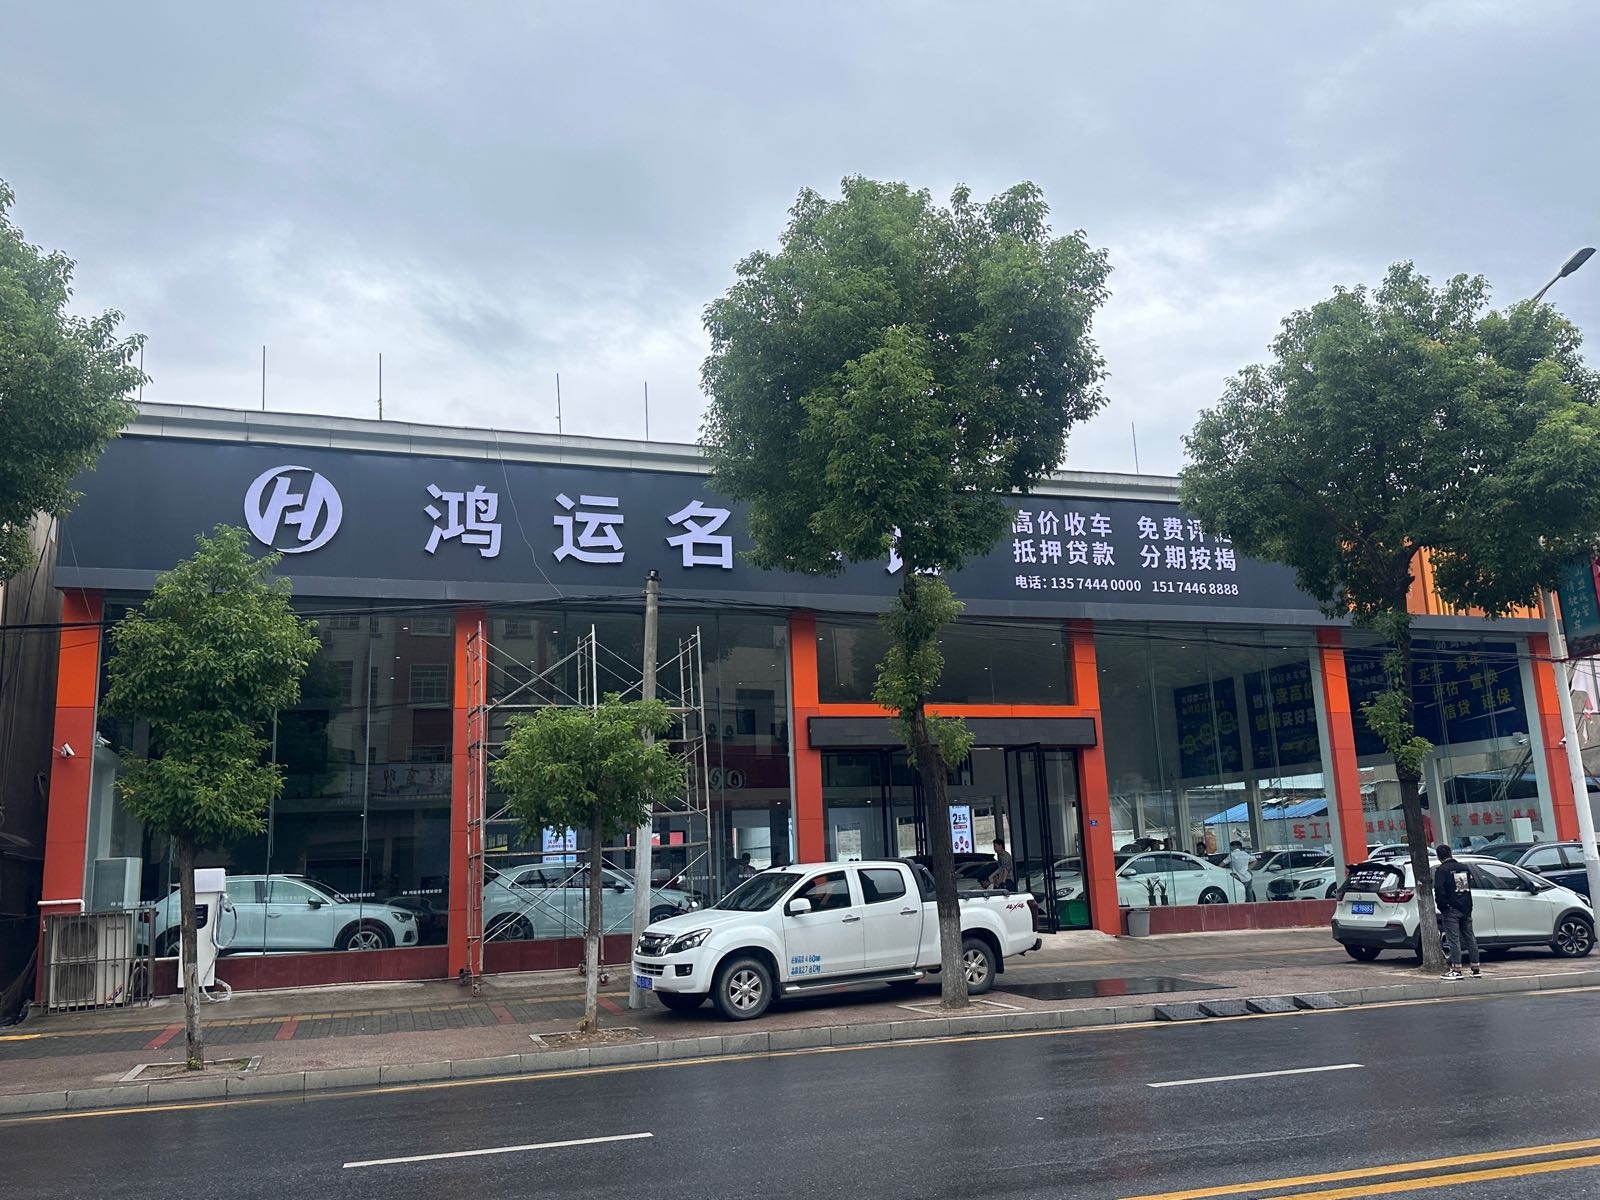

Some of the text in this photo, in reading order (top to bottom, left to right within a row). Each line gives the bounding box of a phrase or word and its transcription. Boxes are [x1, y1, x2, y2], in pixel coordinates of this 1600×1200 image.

[1012, 509, 1113, 537] 高价收车
[1013, 539, 1237, 572] 抵押贷款 分期按揭
[1152, 580, 1239, 596] 15174468888
